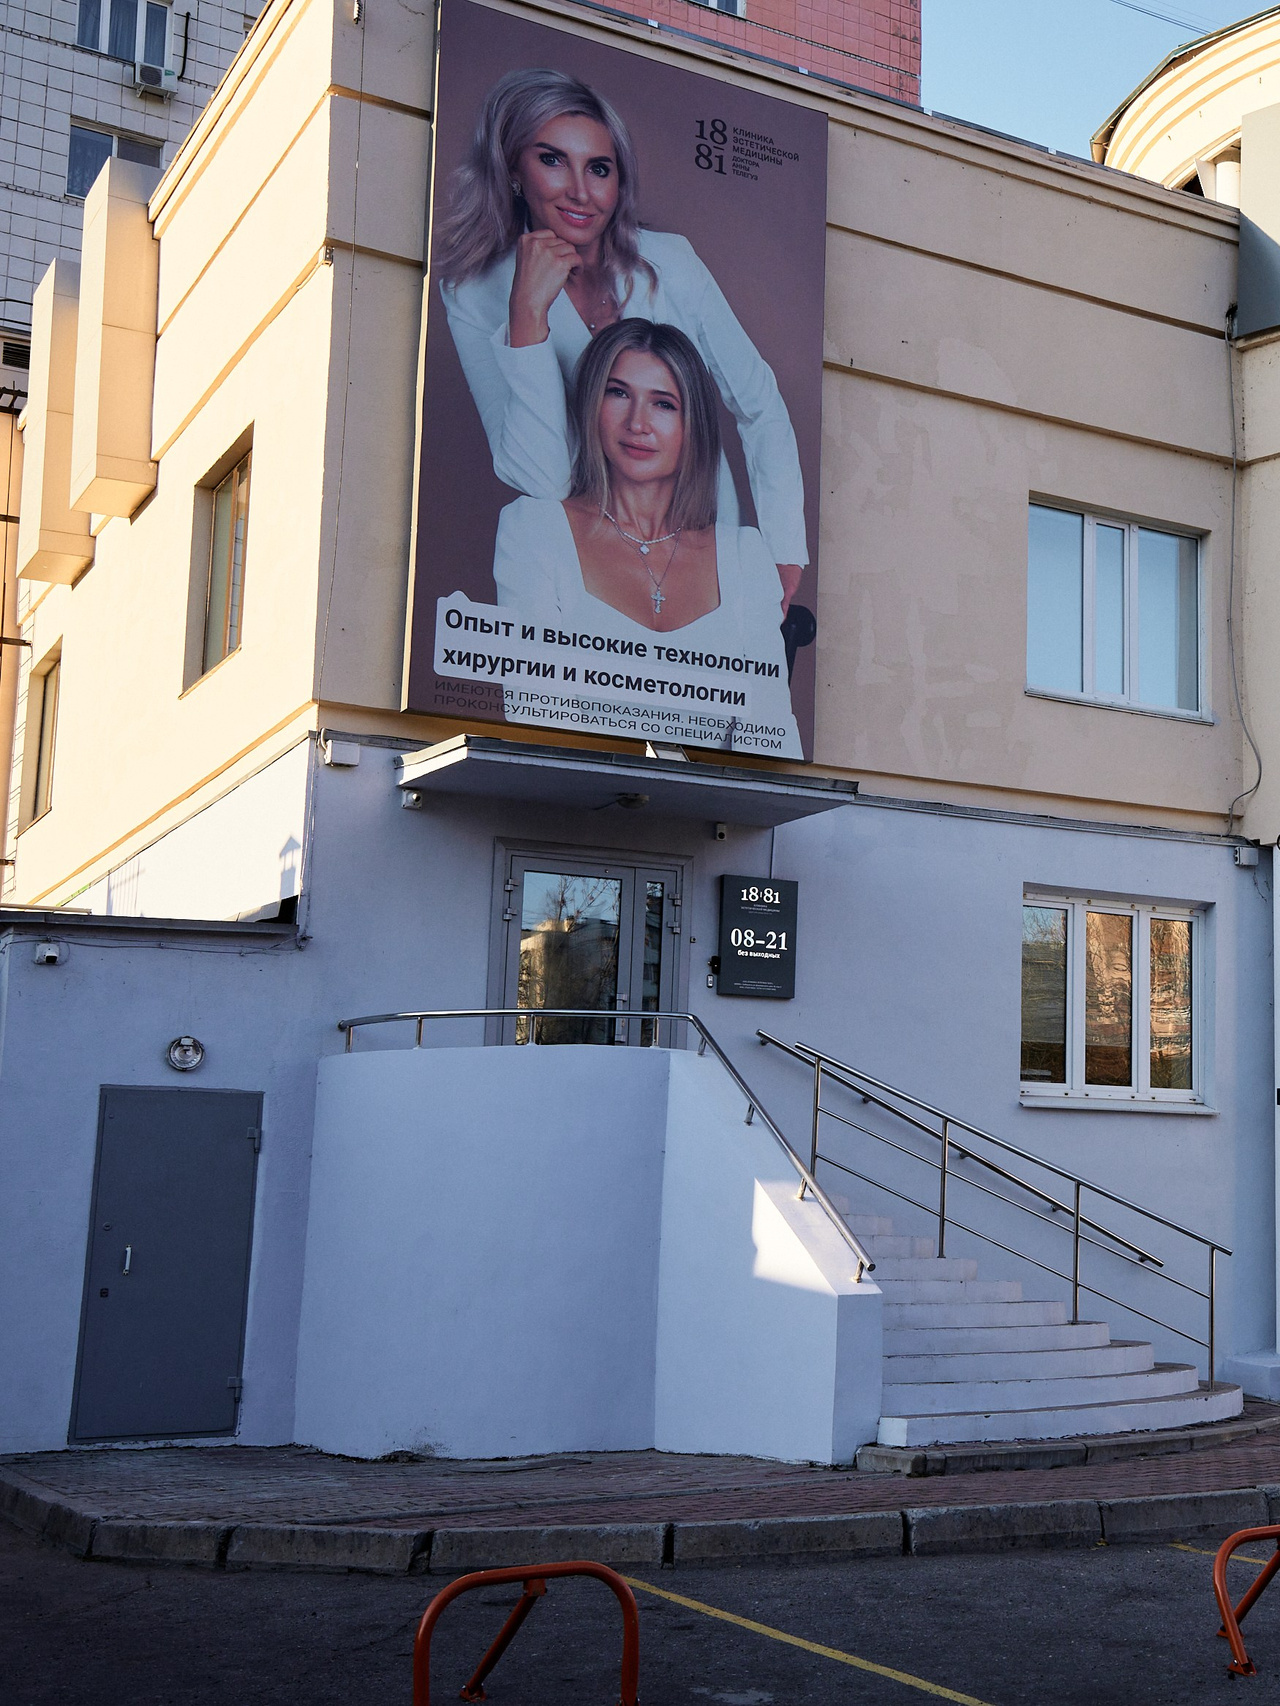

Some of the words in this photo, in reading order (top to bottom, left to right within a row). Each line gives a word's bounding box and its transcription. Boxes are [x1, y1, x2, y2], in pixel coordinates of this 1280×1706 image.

[733, 126, 774, 145] КЛИНИКА
[732, 145, 783, 166] МЕДИЦИНЫ
[732, 156, 760, 168] ДОКТОРА
[733, 136, 800, 162] ЭСТЕТИЧЕСКОЙ
[445, 608, 515, 637] Опыт
[521, 624, 535, 641] и
[543, 628, 647, 658] высокие
[654, 645, 780, 678] технологии
[442, 648, 556, 679] хирургии
[563, 666, 576, 682] и
[584, 669, 746, 706] косметологии
[434, 680, 514, 700] ИМЕЮТСЯ
[518, 691, 684, 724] ПРОТИВОПОКАЗАНИЯ.
[688, 716, 786, 737] НЕОБХОДИМО
[433, 694, 637, 730] ПРОКОНСУЛЬТИРОВАТЬСЯ
[640, 722, 660, 734] СО
[664, 726, 782, 750] СПЕЦИАЛИСТОМ
[737, 949, 748, 957] без
[749, 951, 781, 959] выходных
